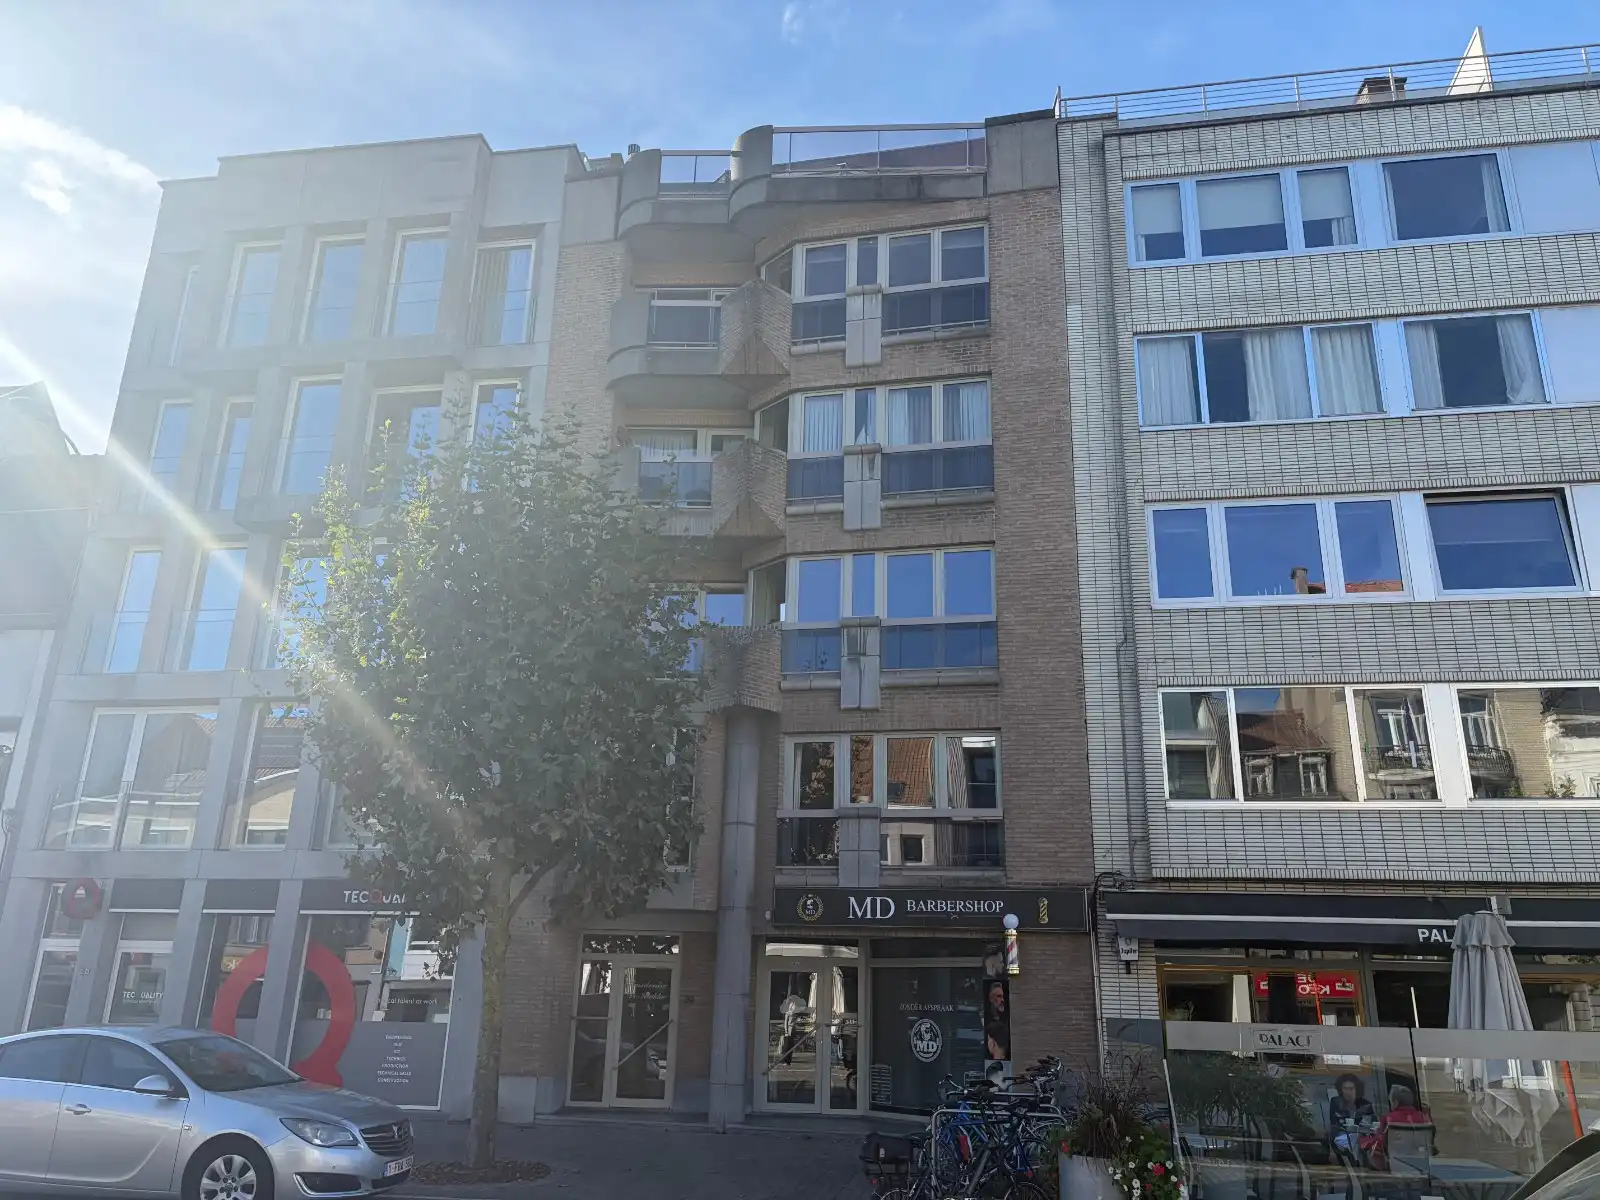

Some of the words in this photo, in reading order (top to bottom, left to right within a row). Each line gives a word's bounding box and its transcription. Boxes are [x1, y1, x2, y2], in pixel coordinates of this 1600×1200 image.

[343, 888, 407, 905] TECQUAL
[846, 896, 896, 919] MD
[905, 899, 1004, 913] BARBERSHOP
[916, 1040, 938, 1053] MD
